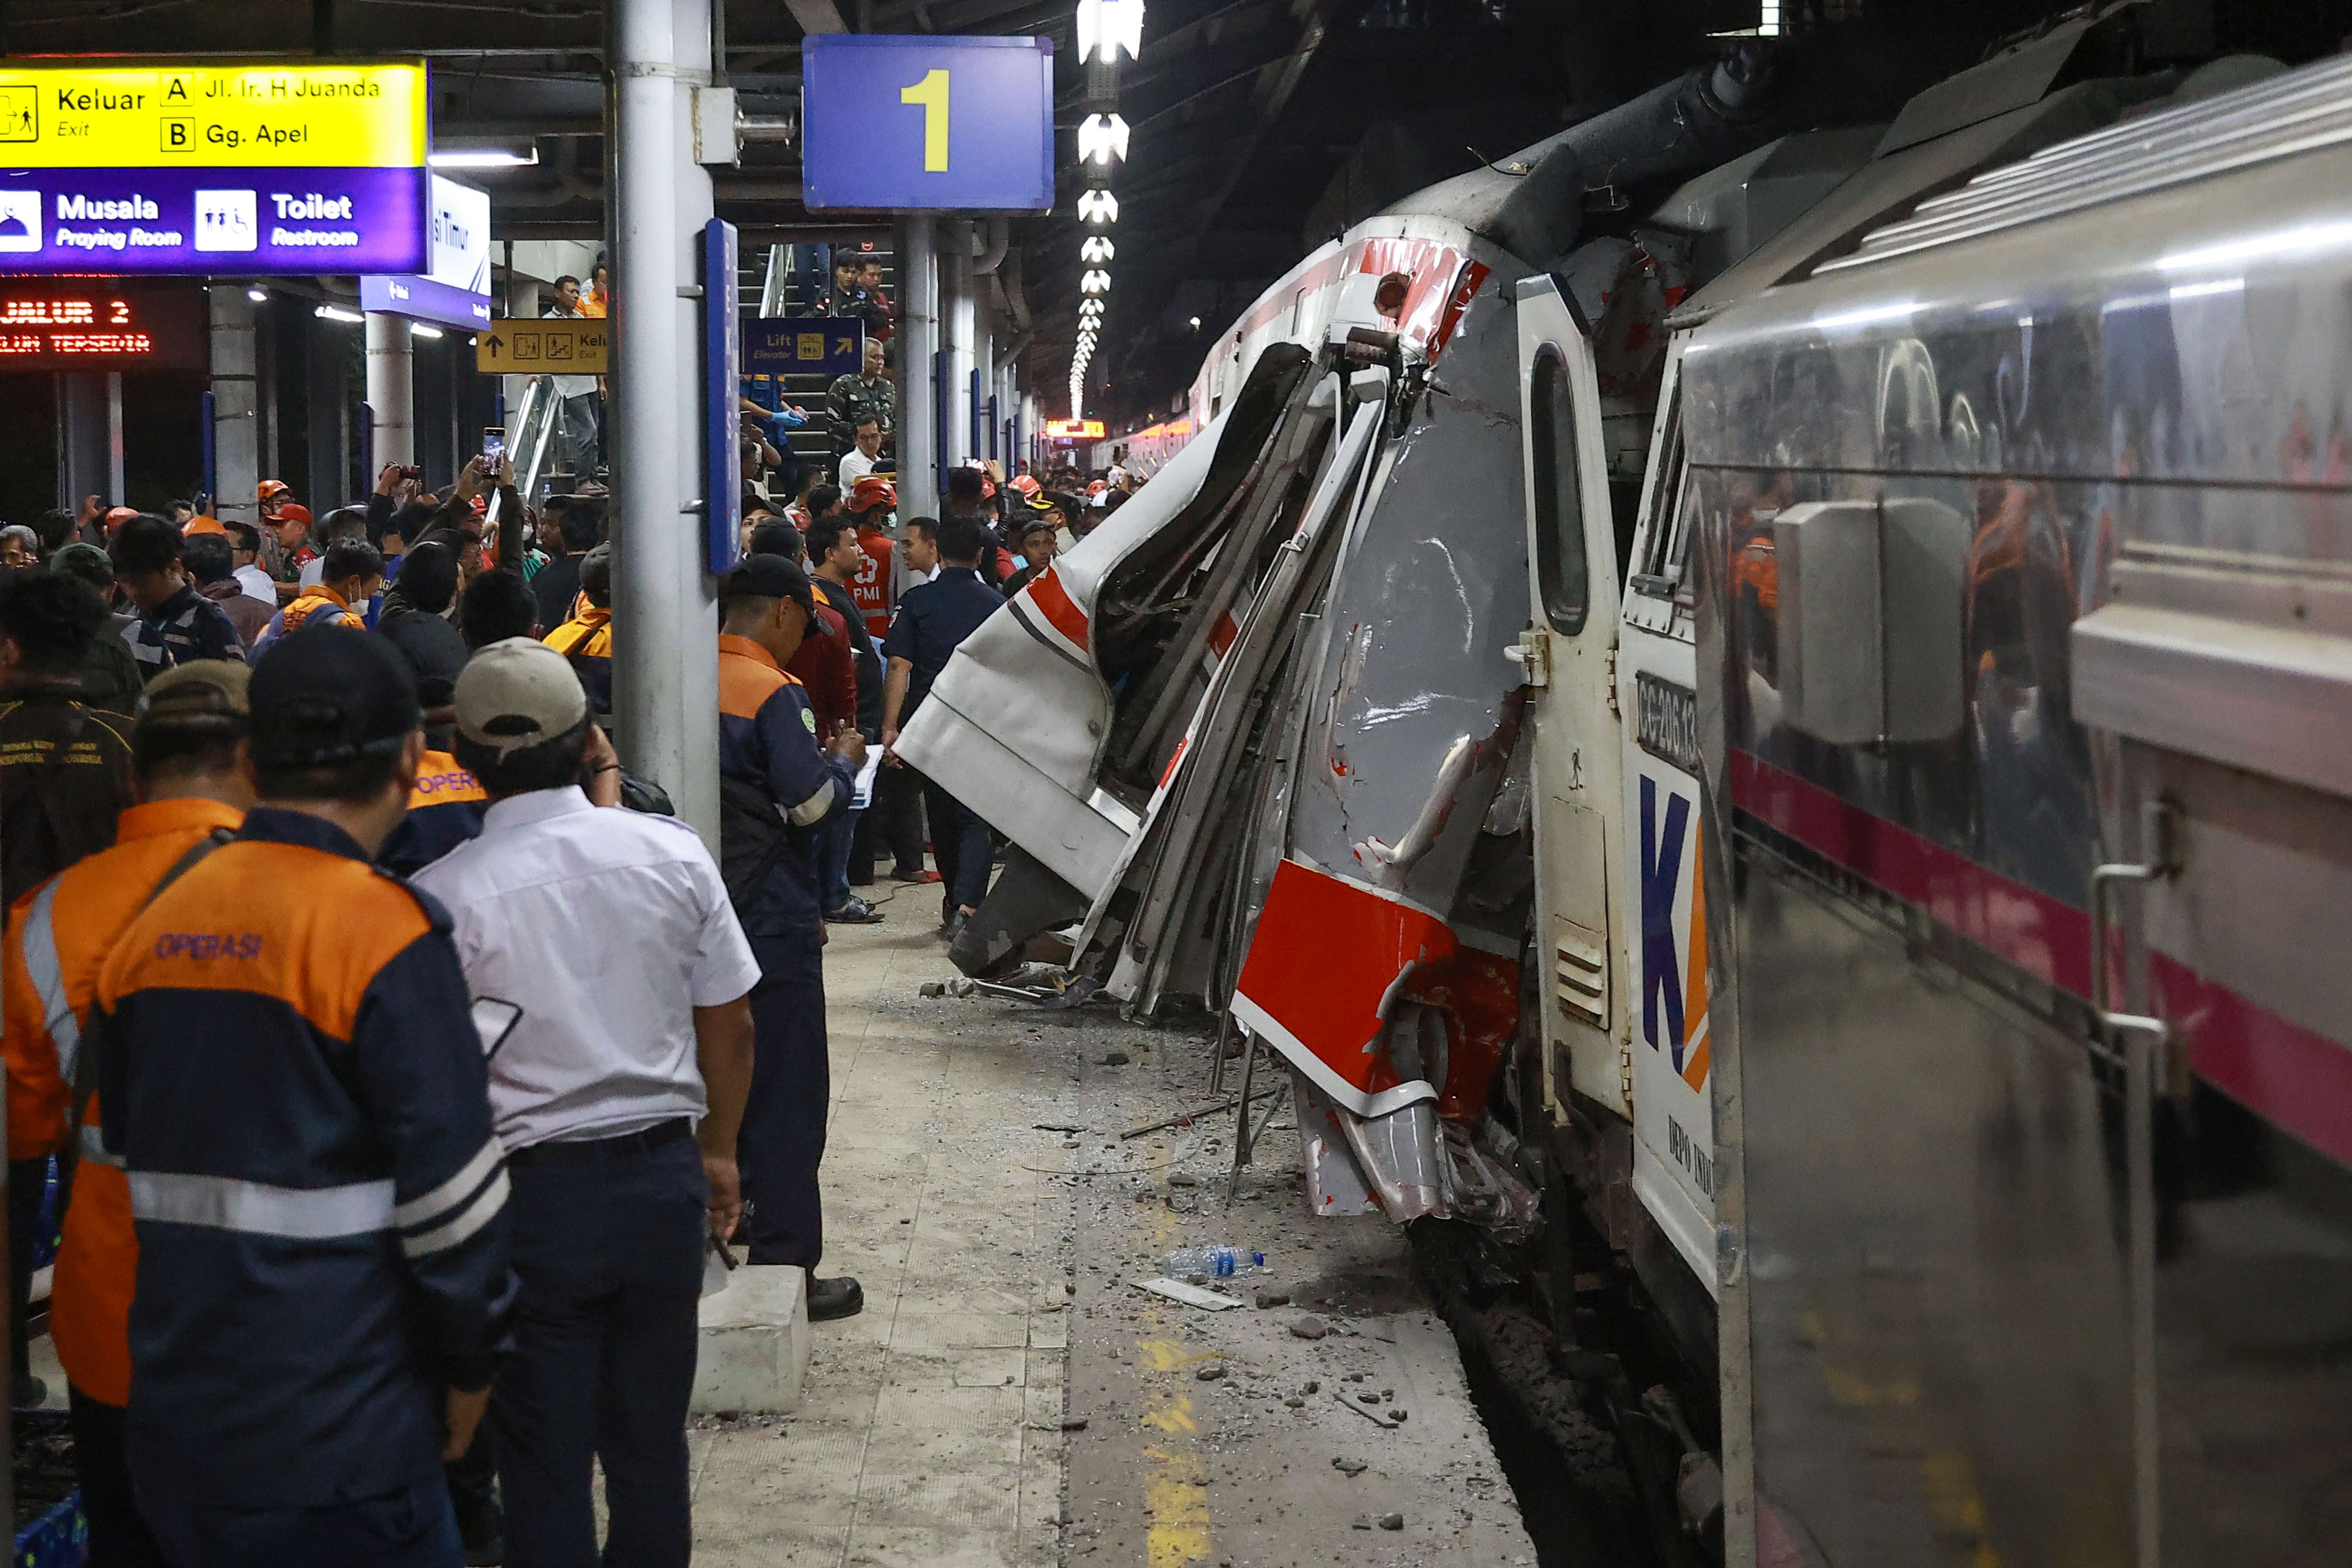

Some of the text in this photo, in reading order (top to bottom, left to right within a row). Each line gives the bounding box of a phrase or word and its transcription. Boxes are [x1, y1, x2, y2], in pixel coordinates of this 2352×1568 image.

[58, 88, 145, 111] Keluar
[167, 79, 187, 100] A
[271, 80, 286, 97] H
[295, 79, 381, 98] Juanda
[57, 121, 90, 137] Exit
[900, 69, 949, 172] 1
[170, 123, 308, 147] B Gg. Apel
[57, 193, 159, 220] Musala
[270, 193, 353, 220] Toilet
[56, 227, 182, 250] Praying Room
[271, 227, 358, 246] Restroom
[443, 211, 469, 251] Timur
[110, 301, 129, 324] 2
[767, 333, 791, 346] Lift
[853, 586, 880, 601] PMI
[418, 771, 478, 794] OPER
[155, 932, 263, 960] OPERASI
[1669, 1114, 1692, 1173] DEPO
